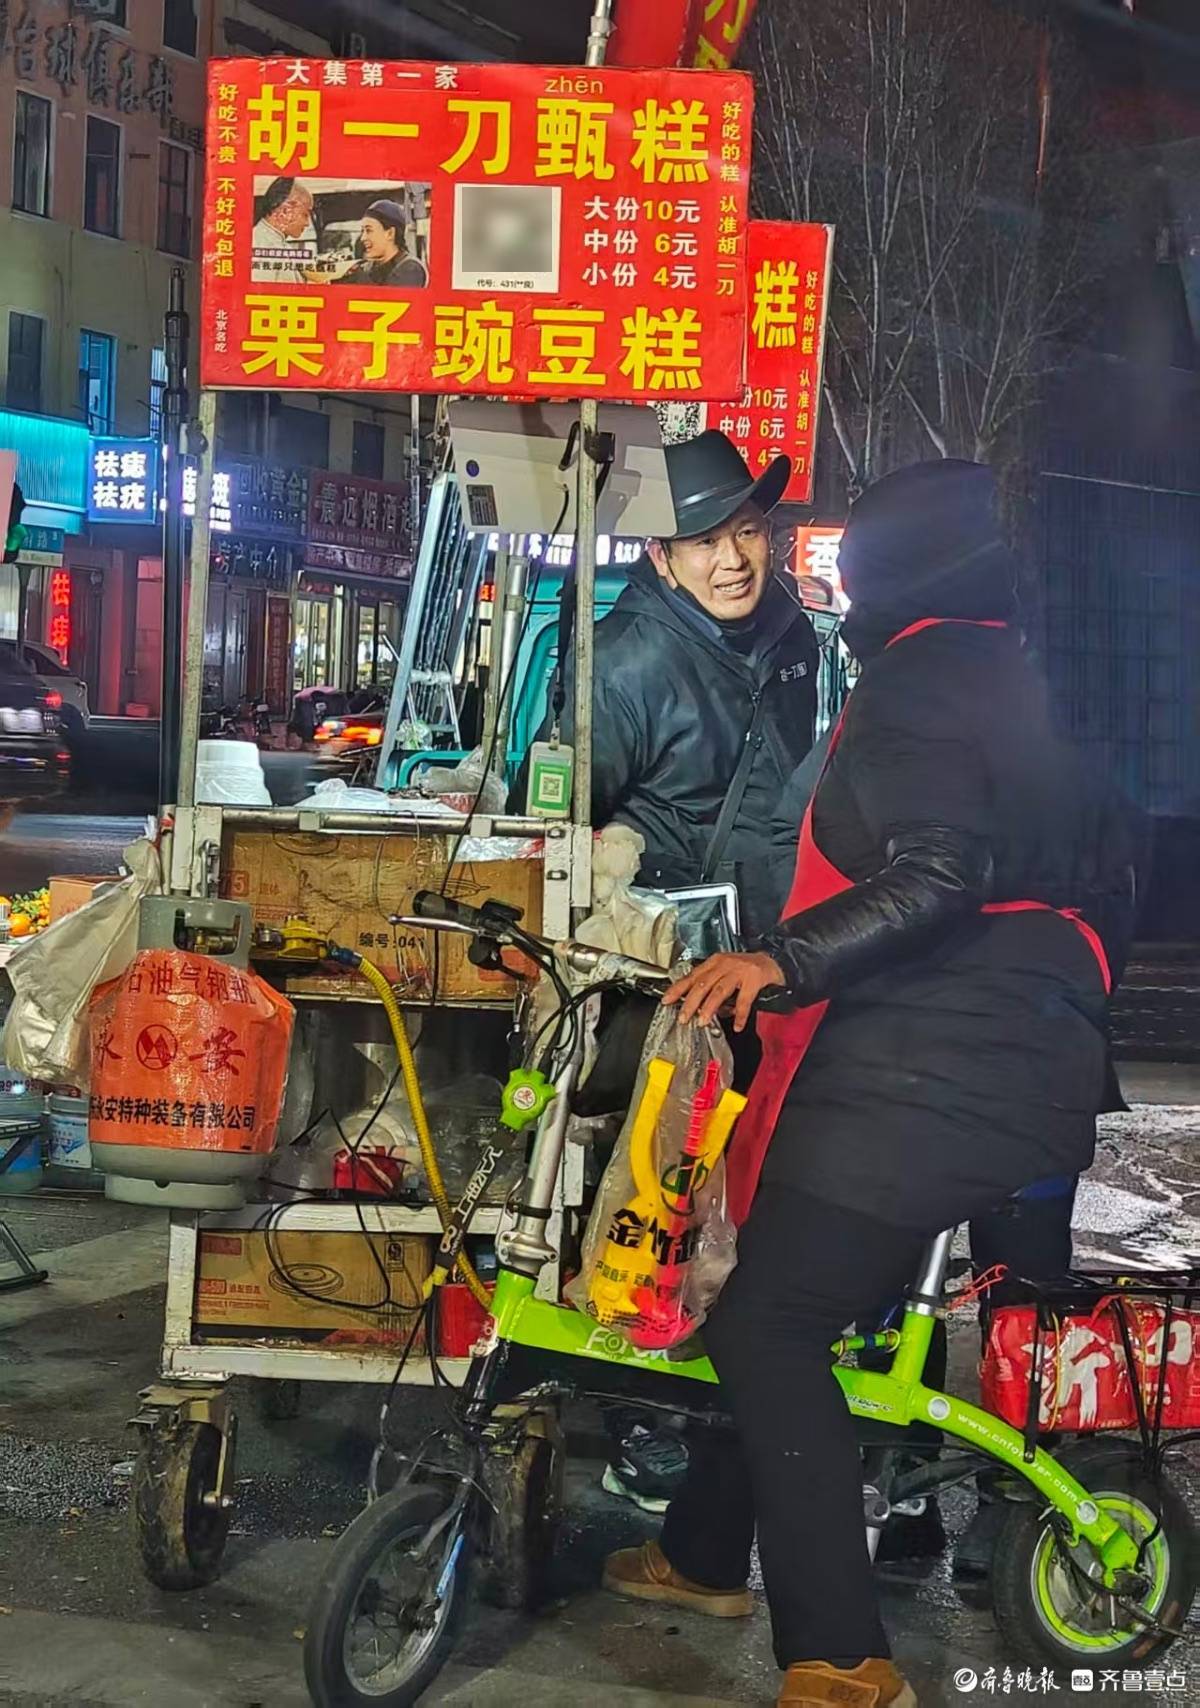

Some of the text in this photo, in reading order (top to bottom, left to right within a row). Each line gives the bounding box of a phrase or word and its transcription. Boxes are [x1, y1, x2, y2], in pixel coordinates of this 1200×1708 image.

[285, 60, 459, 90] 大集第一家
[544, 75, 604, 96] zhēn
[247, 84, 711, 184] 胡一刀甄糕
[214, 83, 239, 278] 好吃不贵 不好吃包退
[715, 101, 743, 296] 好吃的糕 认准胡一刀
[583, 195, 701, 223] 大份10元
[584, 229, 699, 257] 中份 6元
[581, 262, 697, 289] 小份 4元
[752, 260, 800, 349] 糕
[213, 309, 229, 354] 北京名吃
[241, 294, 703, 391] 栗子豌豆糕
[793, 270, 818, 475] 好吃的糕 认准胡一刀
[719, 415, 785, 440] 中份 6元
